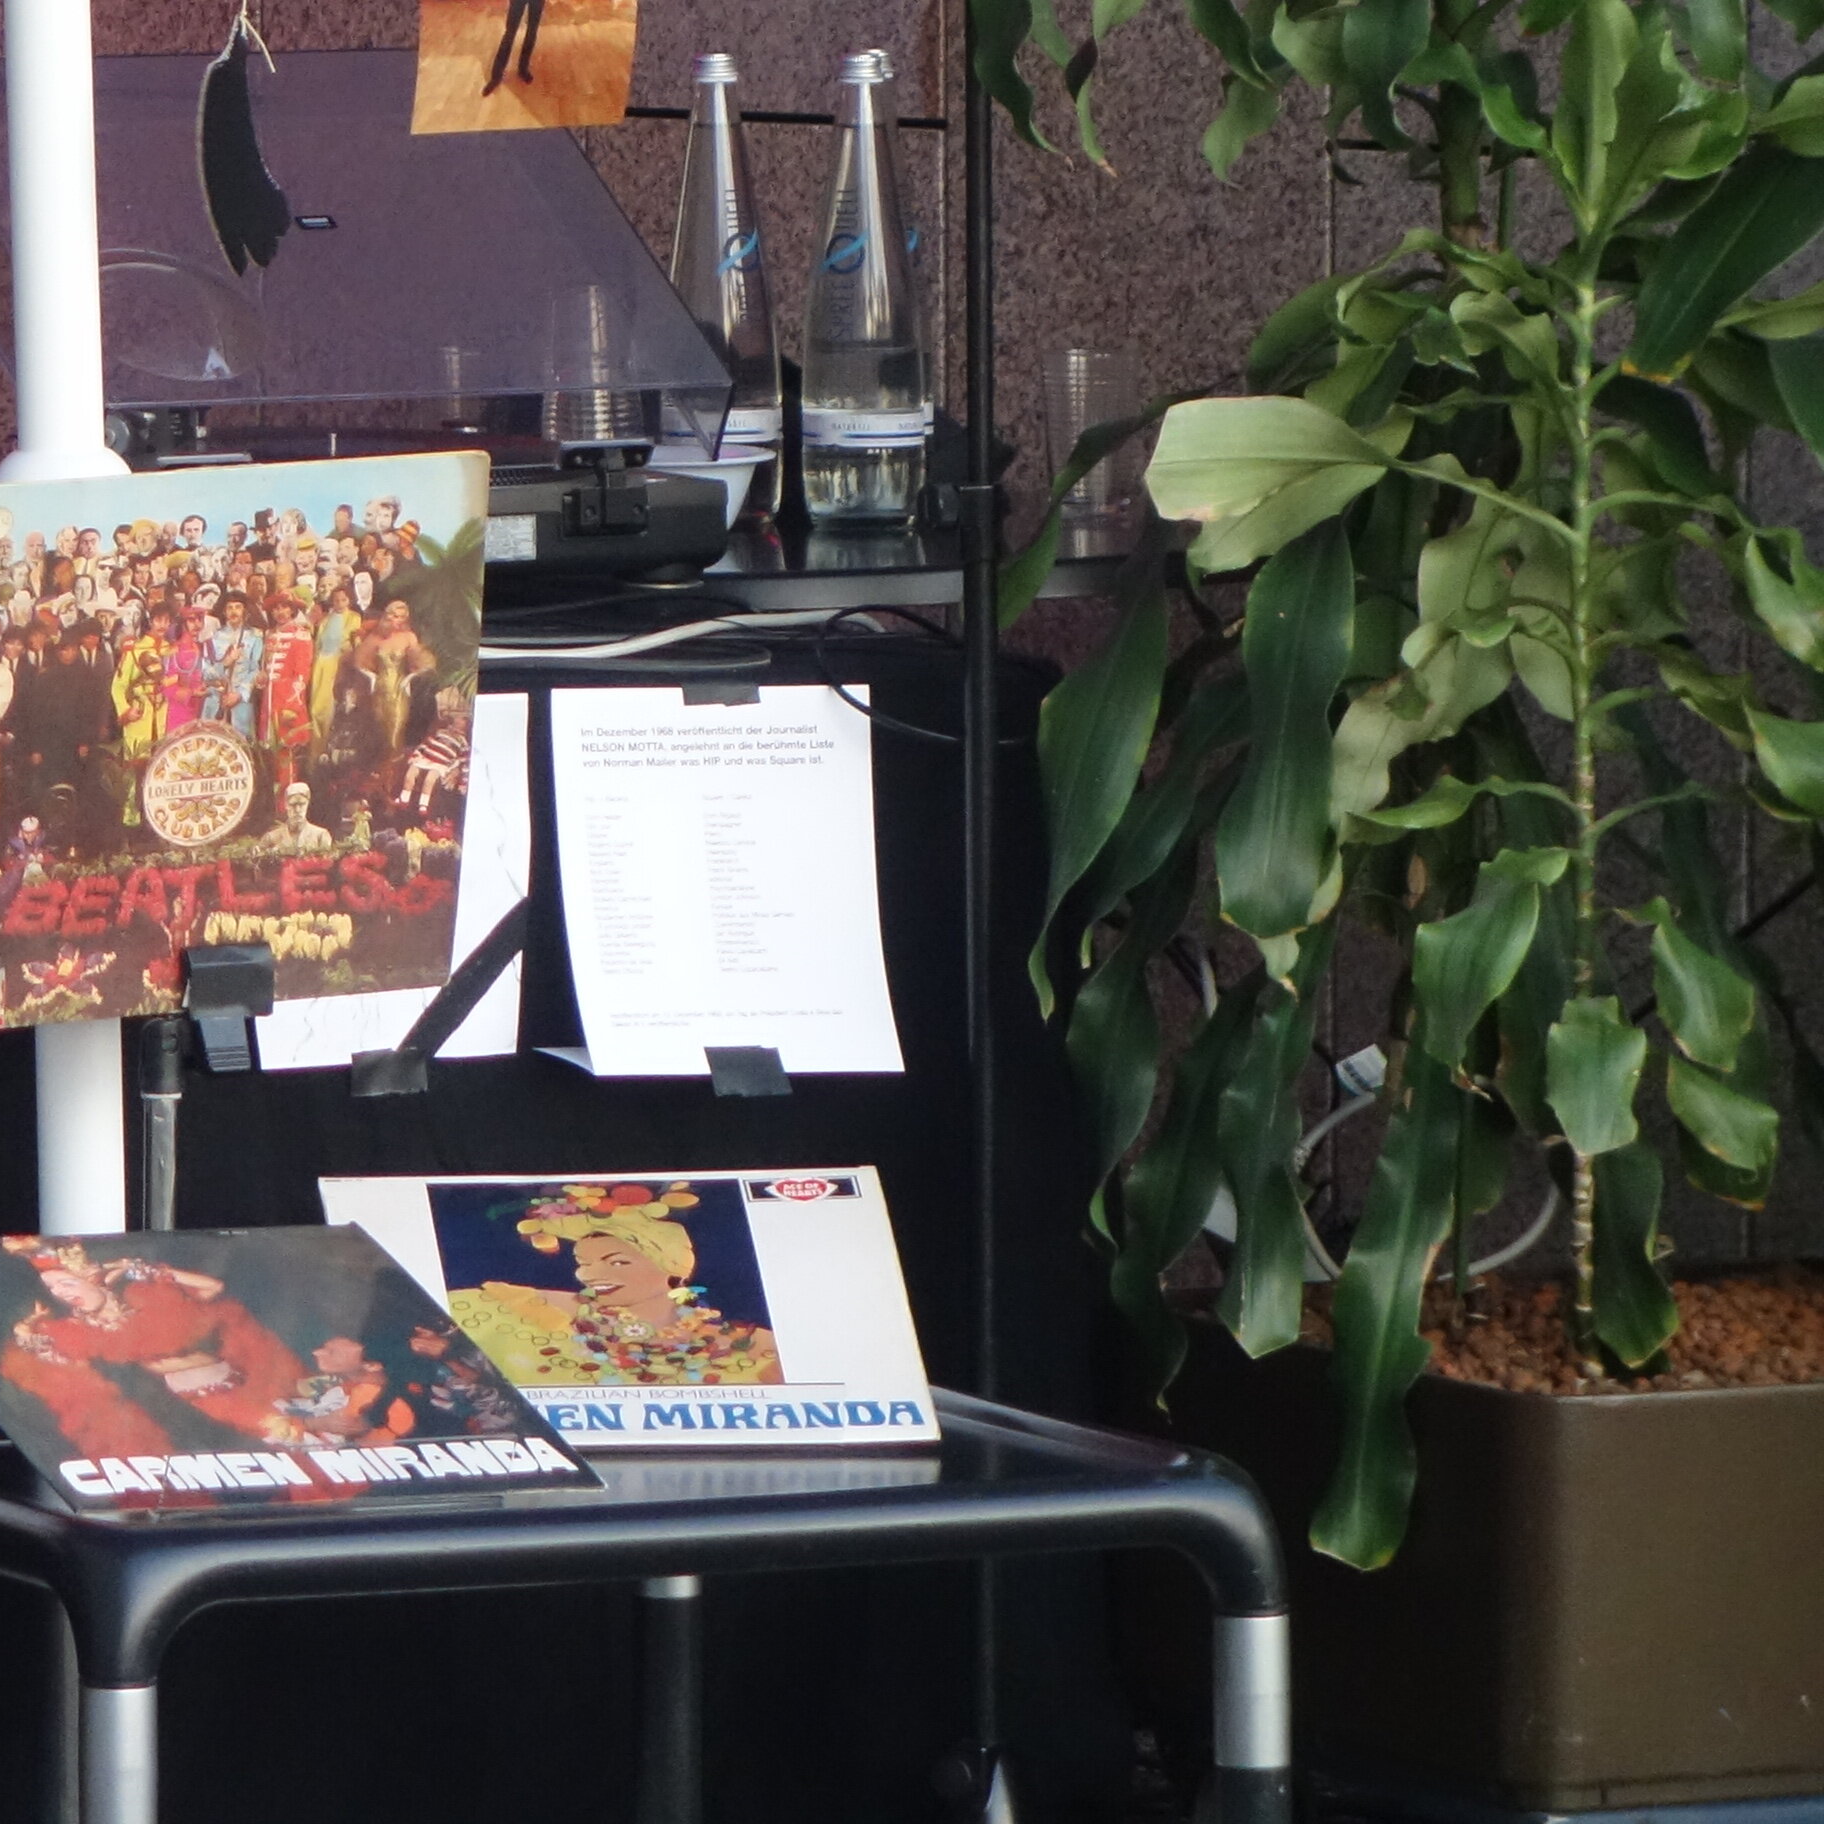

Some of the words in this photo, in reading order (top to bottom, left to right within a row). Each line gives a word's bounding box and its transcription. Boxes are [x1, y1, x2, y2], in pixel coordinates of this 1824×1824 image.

[596, 727, 648, 737] Dezember
[745, 725, 763, 735] der
[766, 724, 818, 735] Journalist
[581, 742, 625, 753] NELSON
[723, 742, 735, 751] an
[738, 740, 753, 751] die
[809, 739, 835, 750] Liste
[583, 759, 600, 768] von
[603, 758, 644, 768] Norman
[680, 758, 701, 767] was
[703, 756, 721, 766] HIP
[724, 756, 744, 766] und
[746, 757, 767, 766] was
[769, 755, 806, 768] Square
[148, 783, 194, 799] LONELY
[200, 778, 249, 794] HEARTS
[1, 851, 388, 936] BEATLES
[526, 1388, 641, 1400] BRAZILIAN
[648, 1388, 772, 1400] BOMBSHELL
[642, 1399, 925, 1431] MIRANDA
[58, 1451, 313, 1495] CARMEN
[308, 1437, 580, 1484] MIRANDA
